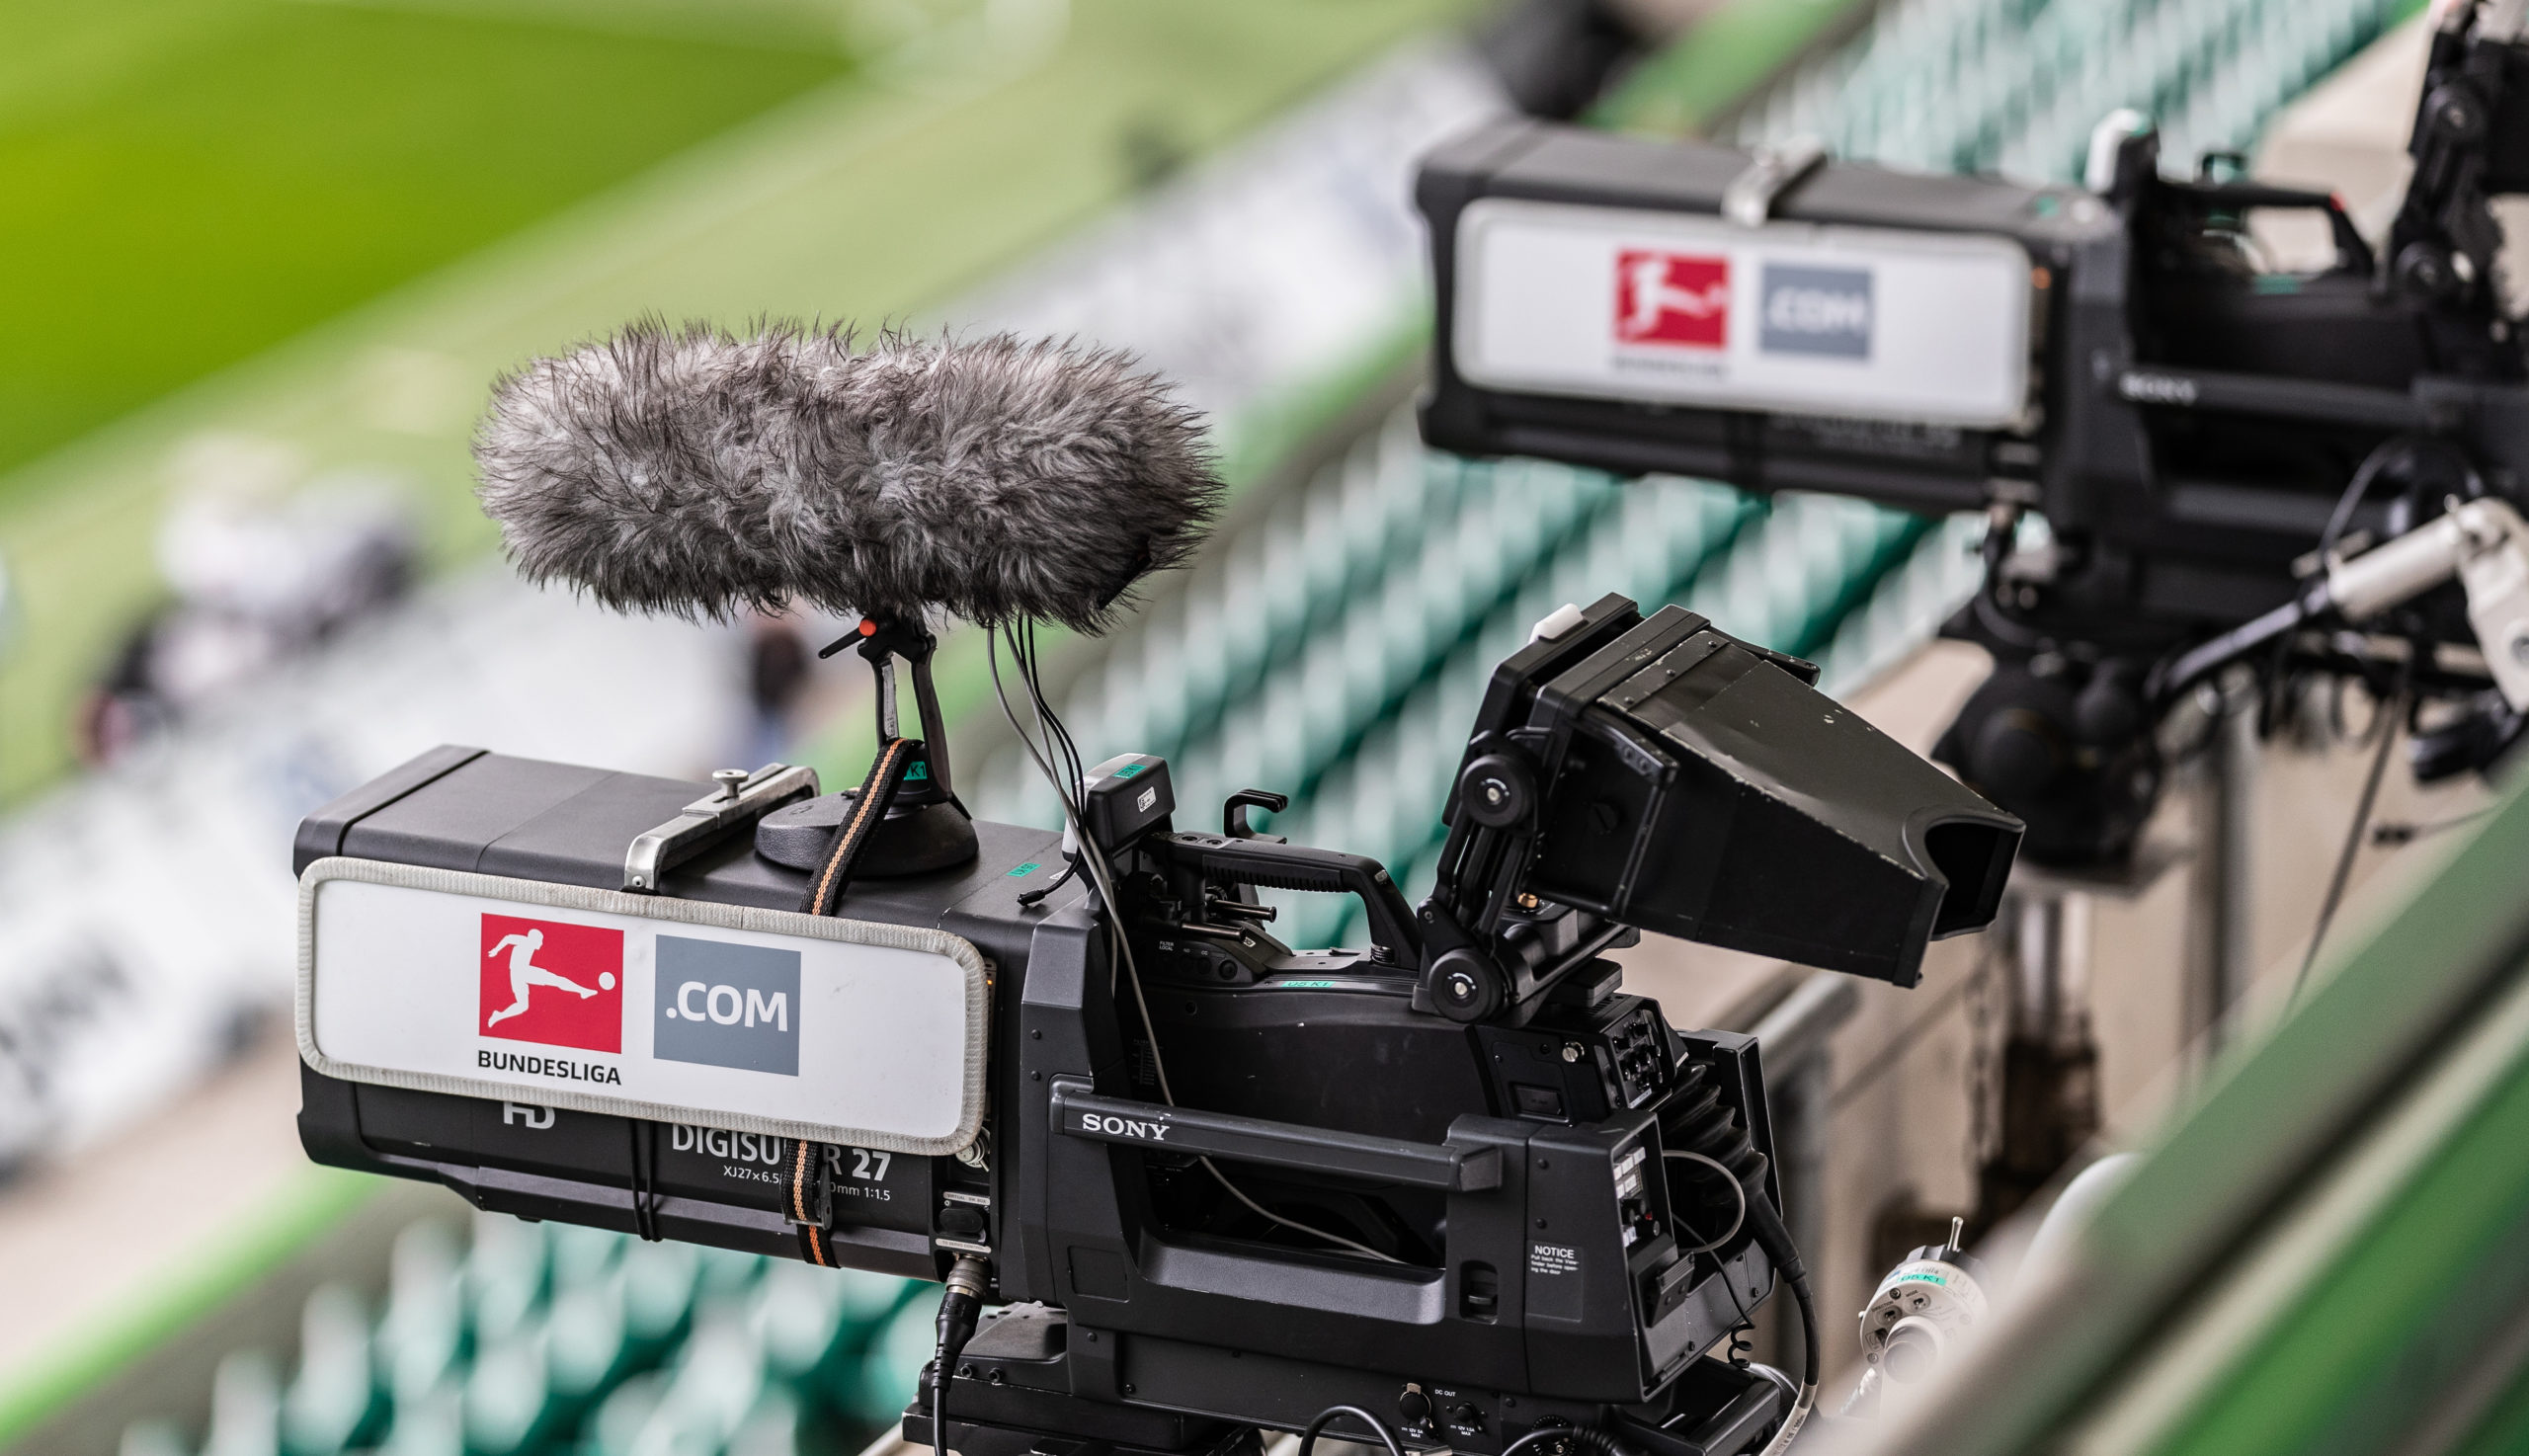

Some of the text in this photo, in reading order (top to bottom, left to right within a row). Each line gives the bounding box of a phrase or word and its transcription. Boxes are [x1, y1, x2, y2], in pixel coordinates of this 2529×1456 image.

[666, 981, 788, 1032] .COM
[478, 1050, 621, 1086] BUNDESLIGA
[1082, 1113, 1171, 1141] SONY
[852, 1148, 891, 1181] 27
[863, 1186, 891, 1201] 1:1.5
[1534, 1245, 1575, 1259] NOTICE
